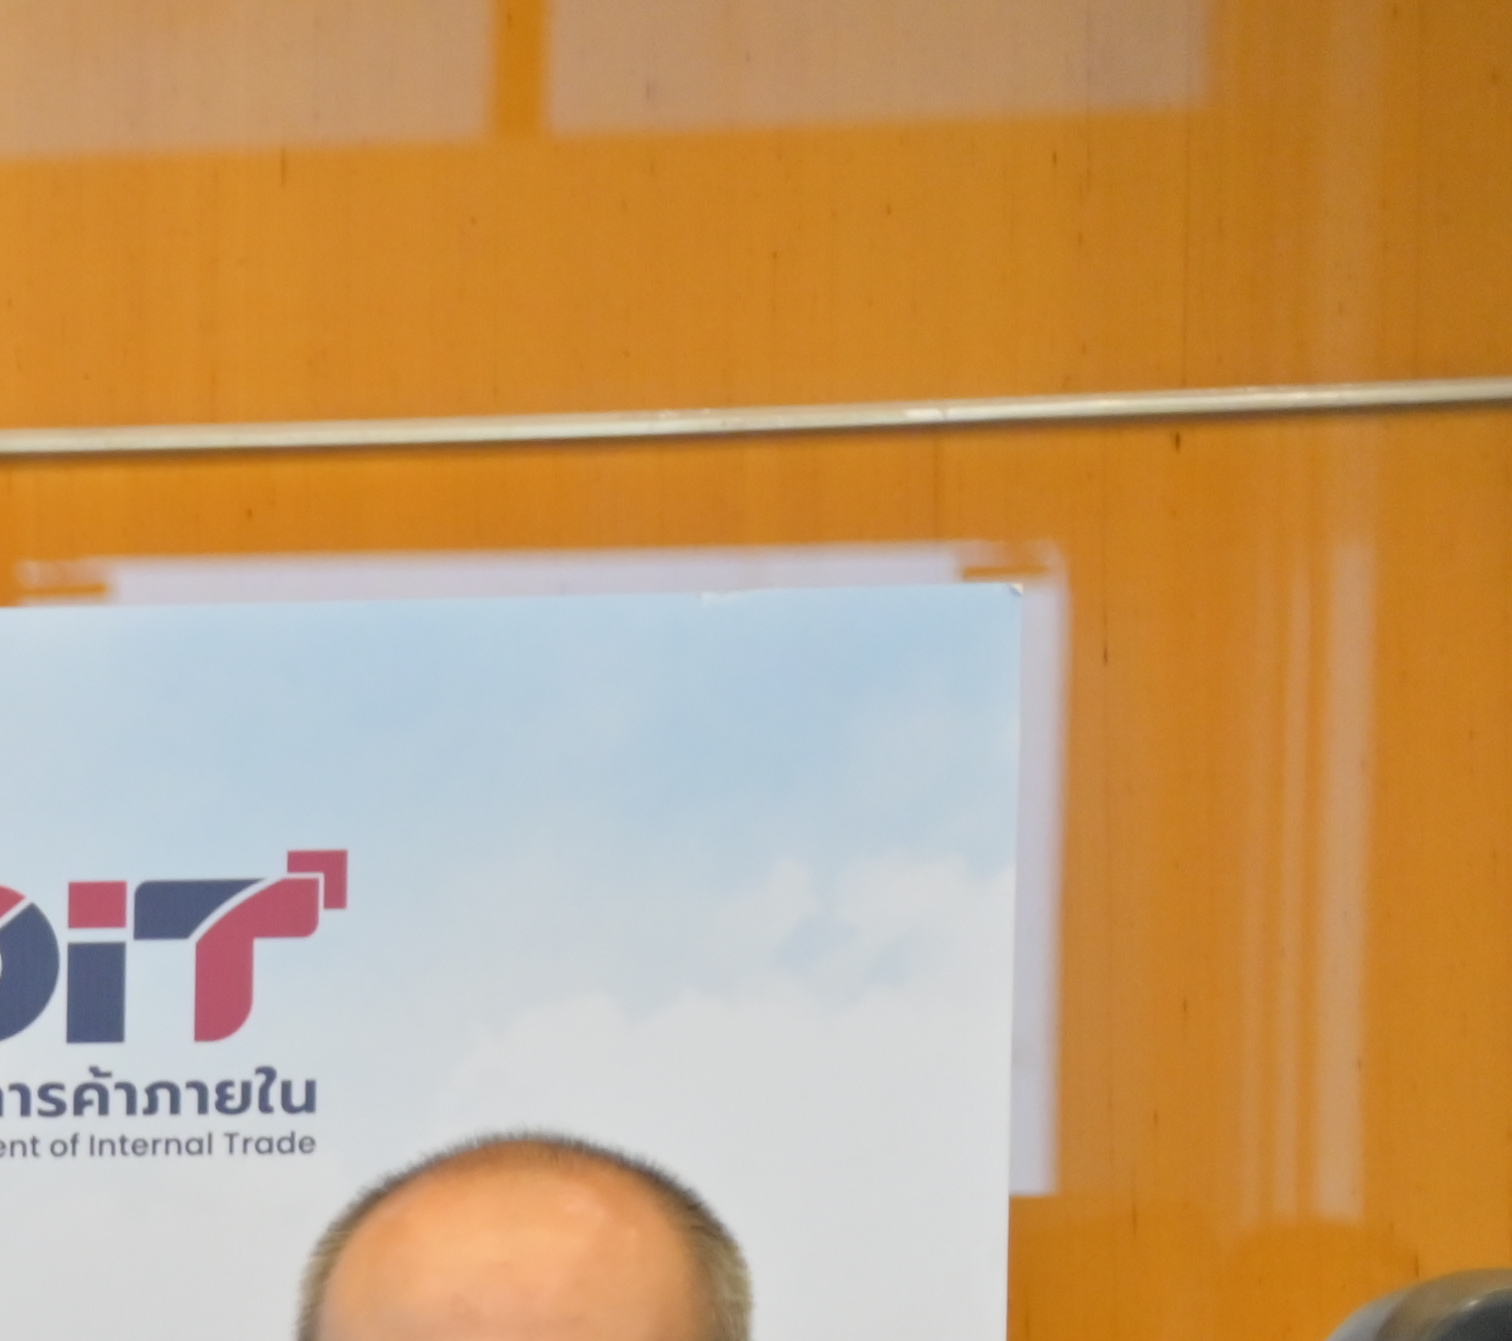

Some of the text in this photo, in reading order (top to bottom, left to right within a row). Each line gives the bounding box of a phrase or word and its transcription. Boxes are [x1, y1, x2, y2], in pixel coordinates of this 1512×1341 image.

[49, 1132, 81, 1158] of
[89, 1132, 214, 1157] Internal
[222, 1130, 317, 1156] Trade
